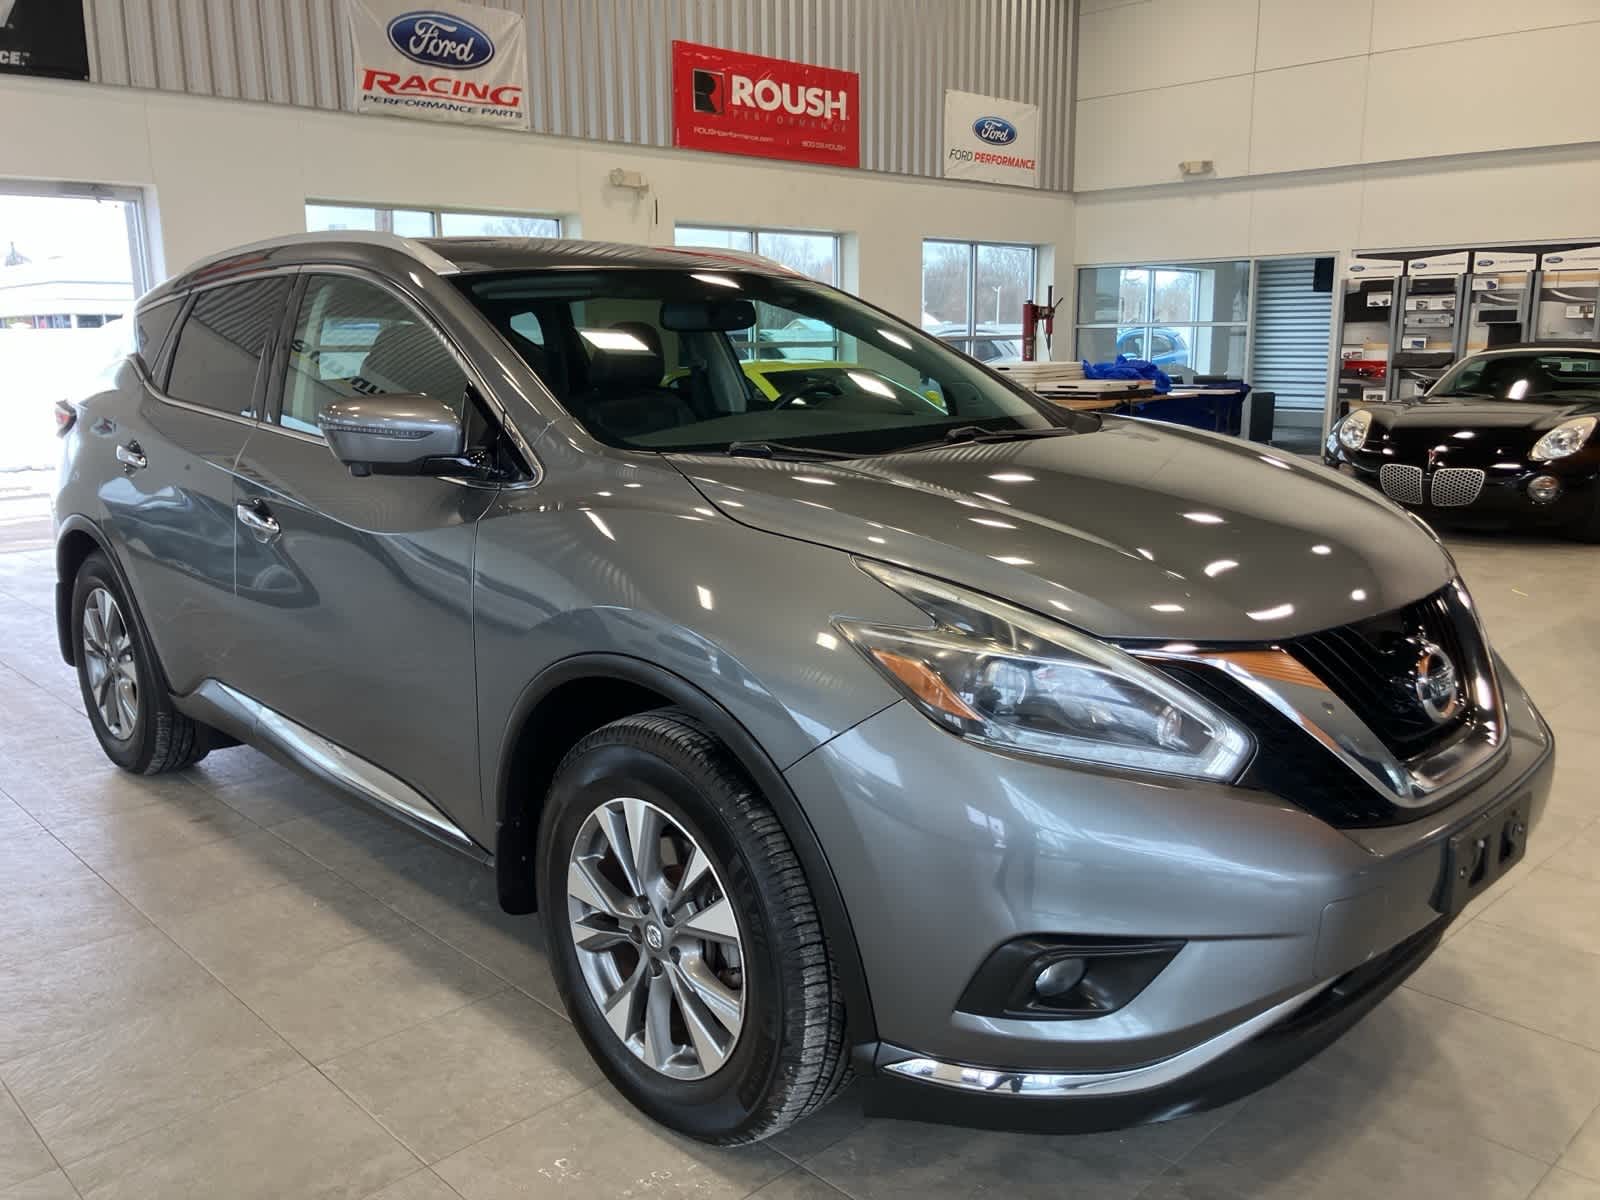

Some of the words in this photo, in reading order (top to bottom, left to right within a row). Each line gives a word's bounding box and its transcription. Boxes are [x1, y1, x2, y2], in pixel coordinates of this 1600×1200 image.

[409, 19, 475, 62] Ford
[362, 68, 522, 107] RACING
[731, 74, 847, 121] ROUSH
[363, 94, 474, 114] PERFORMANCE
[481, 107, 523, 119] PARTS
[732, 109, 848, 133] PERFORMANCE
[981, 120, 1009, 141] Ford
[948, 148, 973, 161] FORD
[974, 152, 1036, 170] PERFORMANCE
